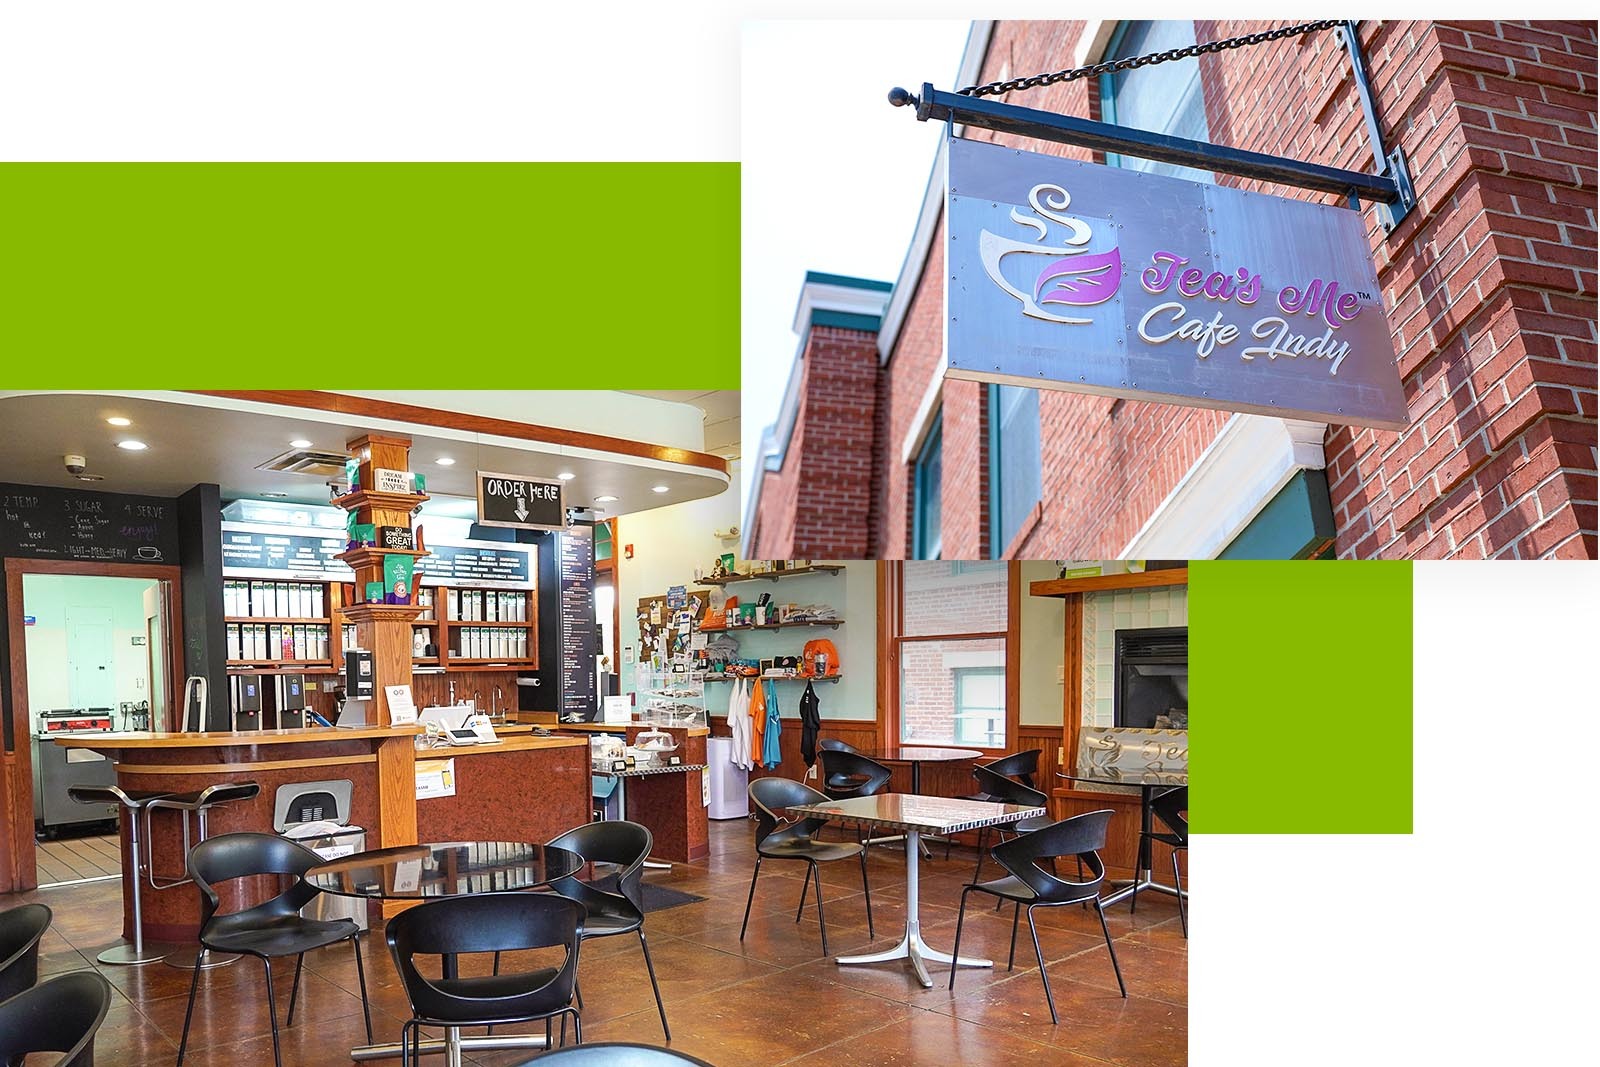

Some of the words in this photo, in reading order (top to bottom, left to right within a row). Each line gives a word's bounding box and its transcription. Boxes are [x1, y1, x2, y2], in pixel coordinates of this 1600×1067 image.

[1140, 250, 1263, 304] Tea's
[1277, 278, 1362, 329] Me
[1137, 302, 1240, 359] Cafe
[1241, 316, 1353, 376] Indy
[487, 479, 527, 499] ORDER
[529, 483, 559, 503] HERE
[3, 495, 10, 507] 2
[12, 496, 39, 508] TEMP
[64, 500, 71, 512] 3
[75, 500, 104, 513] SUGAR
[124, 504, 132, 516] 4
[137, 504, 165, 520] SERVE
[385, 530, 412, 538] SOMETHING
[385, 535, 412, 546] GREAT
